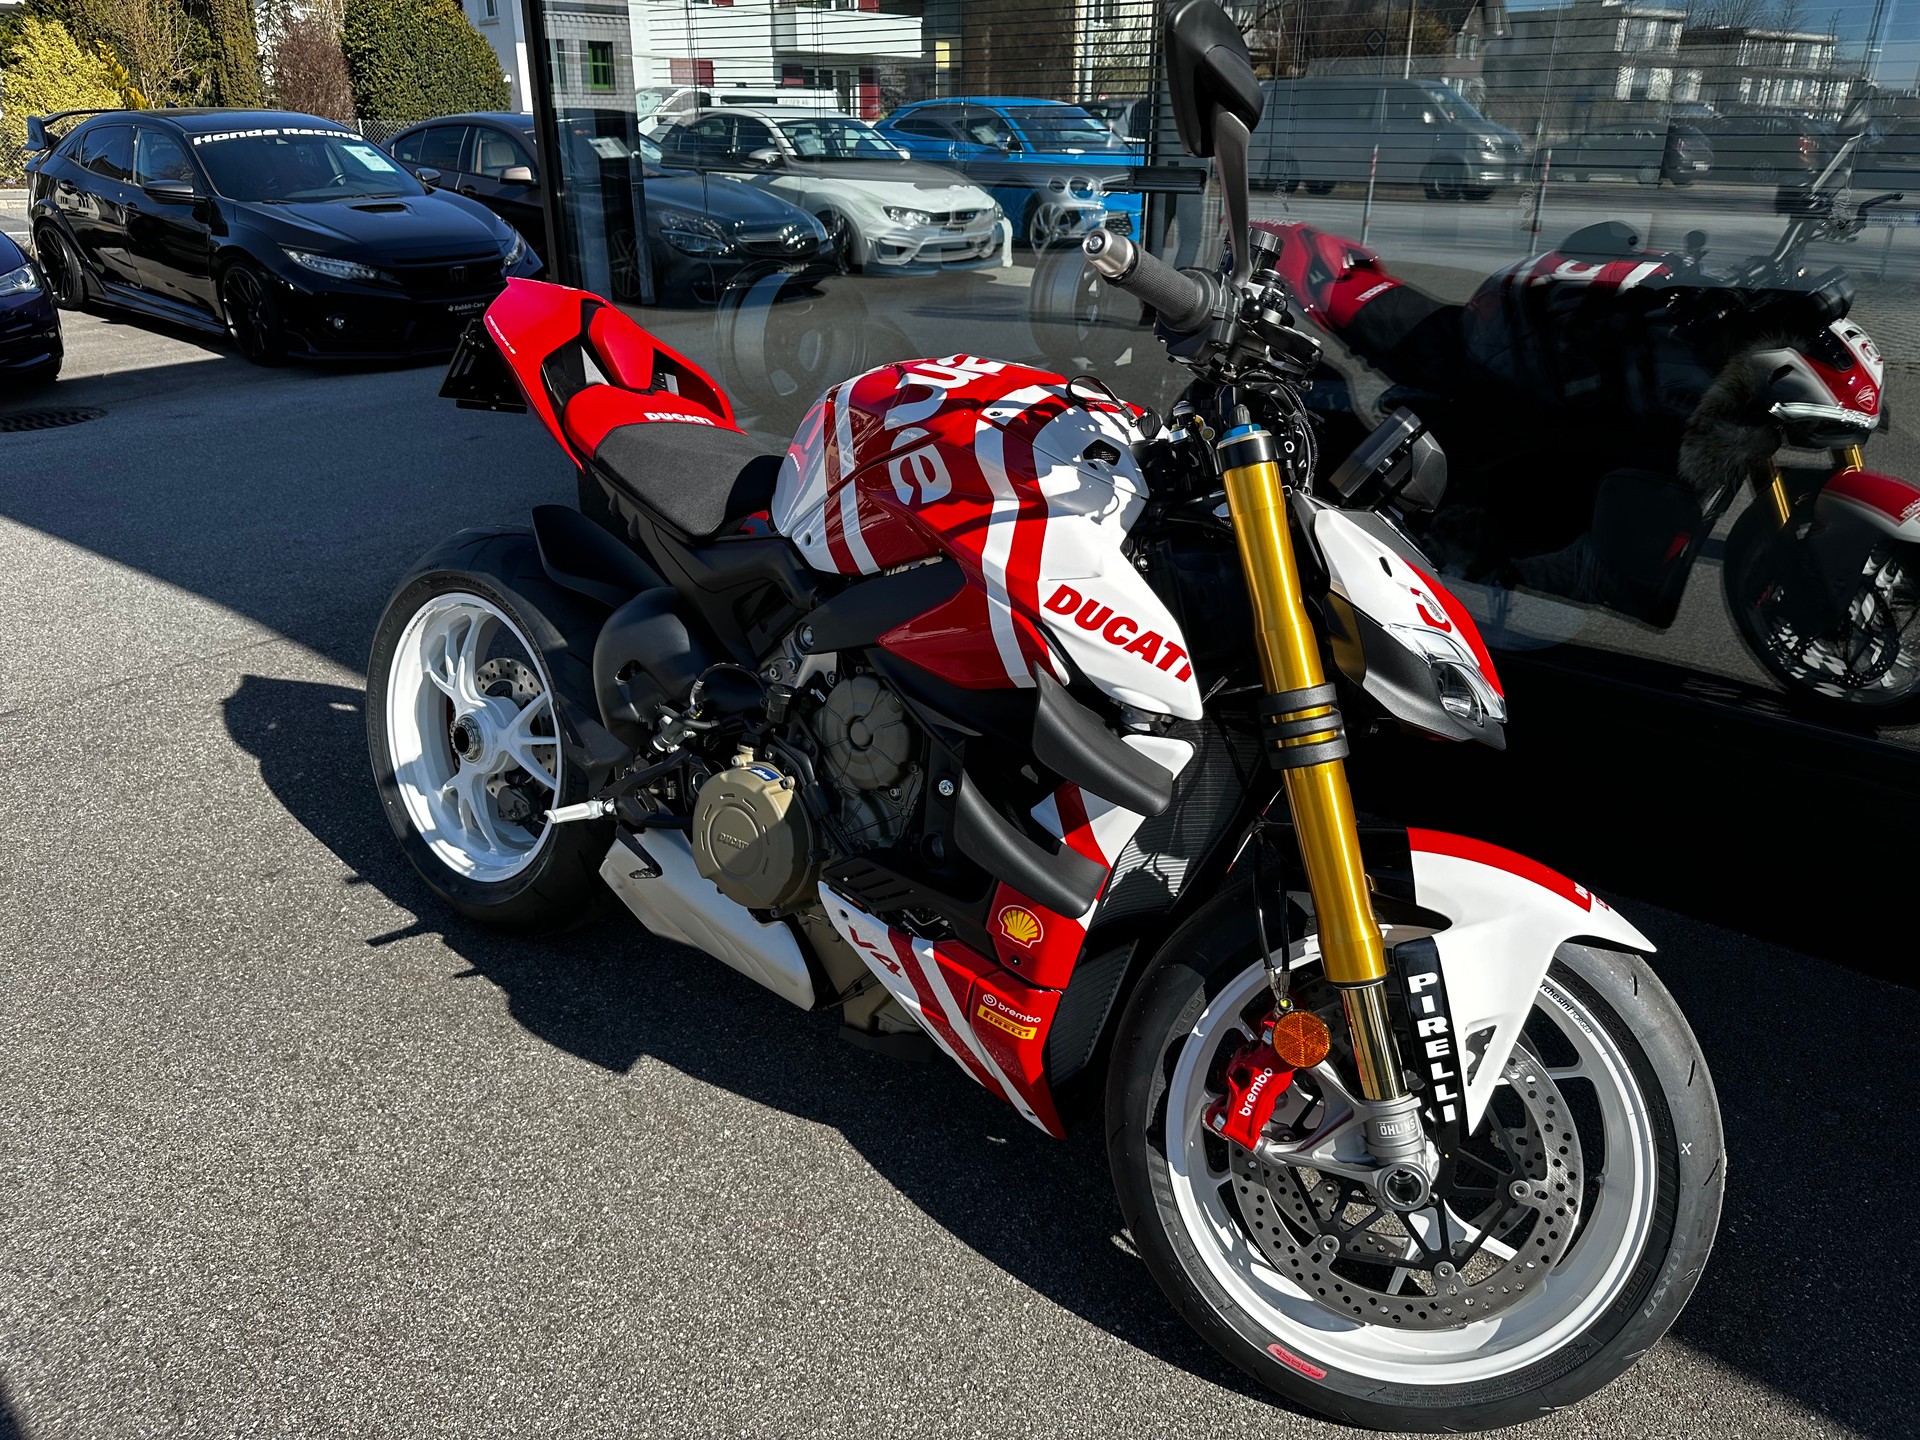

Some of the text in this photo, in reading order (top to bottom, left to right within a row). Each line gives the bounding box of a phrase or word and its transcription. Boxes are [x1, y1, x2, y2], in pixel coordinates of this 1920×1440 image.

[193, 128, 363, 146] Honda Racing
[643, 412, 715, 426] DUCATI
[1043, 583, 1193, 683] DUCATI
[717, 832, 750, 851] DUCATI
[848, 924, 902, 978] V4
[982, 1008, 1032, 1038] PIRELLI
[998, 1002, 1042, 1023] brembo
[1570, 1010, 1593, 1034] FORGED
[1407, 971, 1458, 1123] PIRELLI
[1238, 1067, 1273, 1117] brembo
[1379, 1118, 1416, 1136] ÖHLINS
[1643, 1233, 1687, 1319] CORSA
